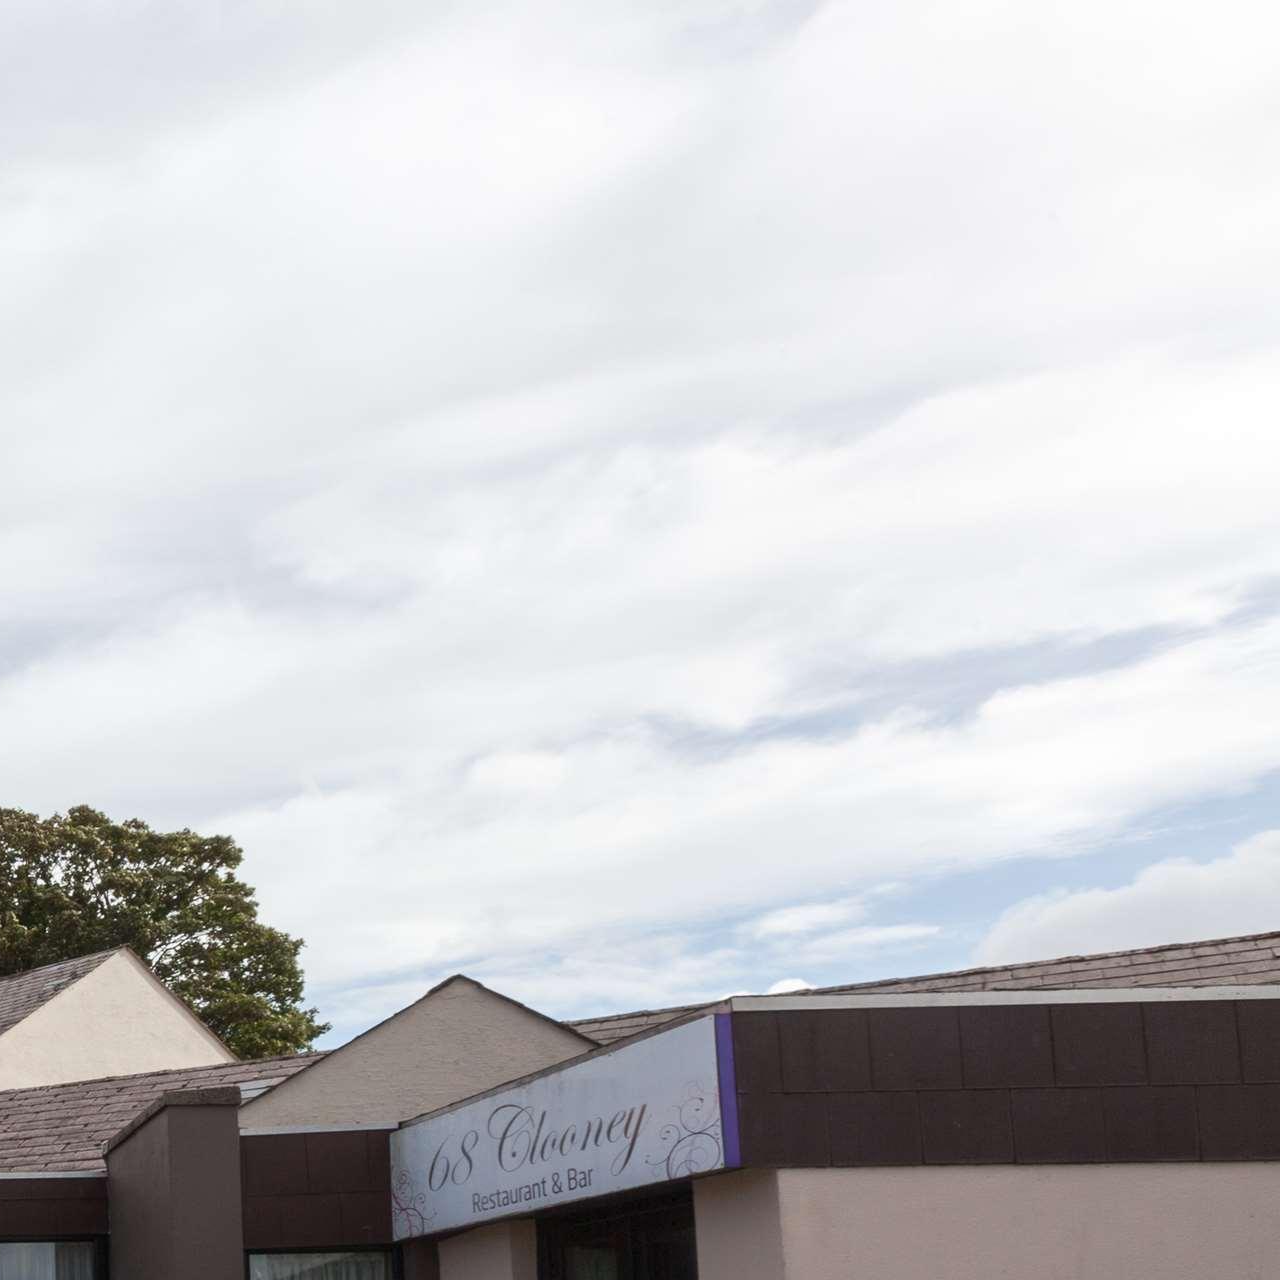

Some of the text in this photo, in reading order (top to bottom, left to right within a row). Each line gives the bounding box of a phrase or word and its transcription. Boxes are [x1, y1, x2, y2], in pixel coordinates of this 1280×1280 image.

[428, 1103, 647, 1192] 68 Clooney
[472, 1167, 593, 1213] Restaurant & Bar
